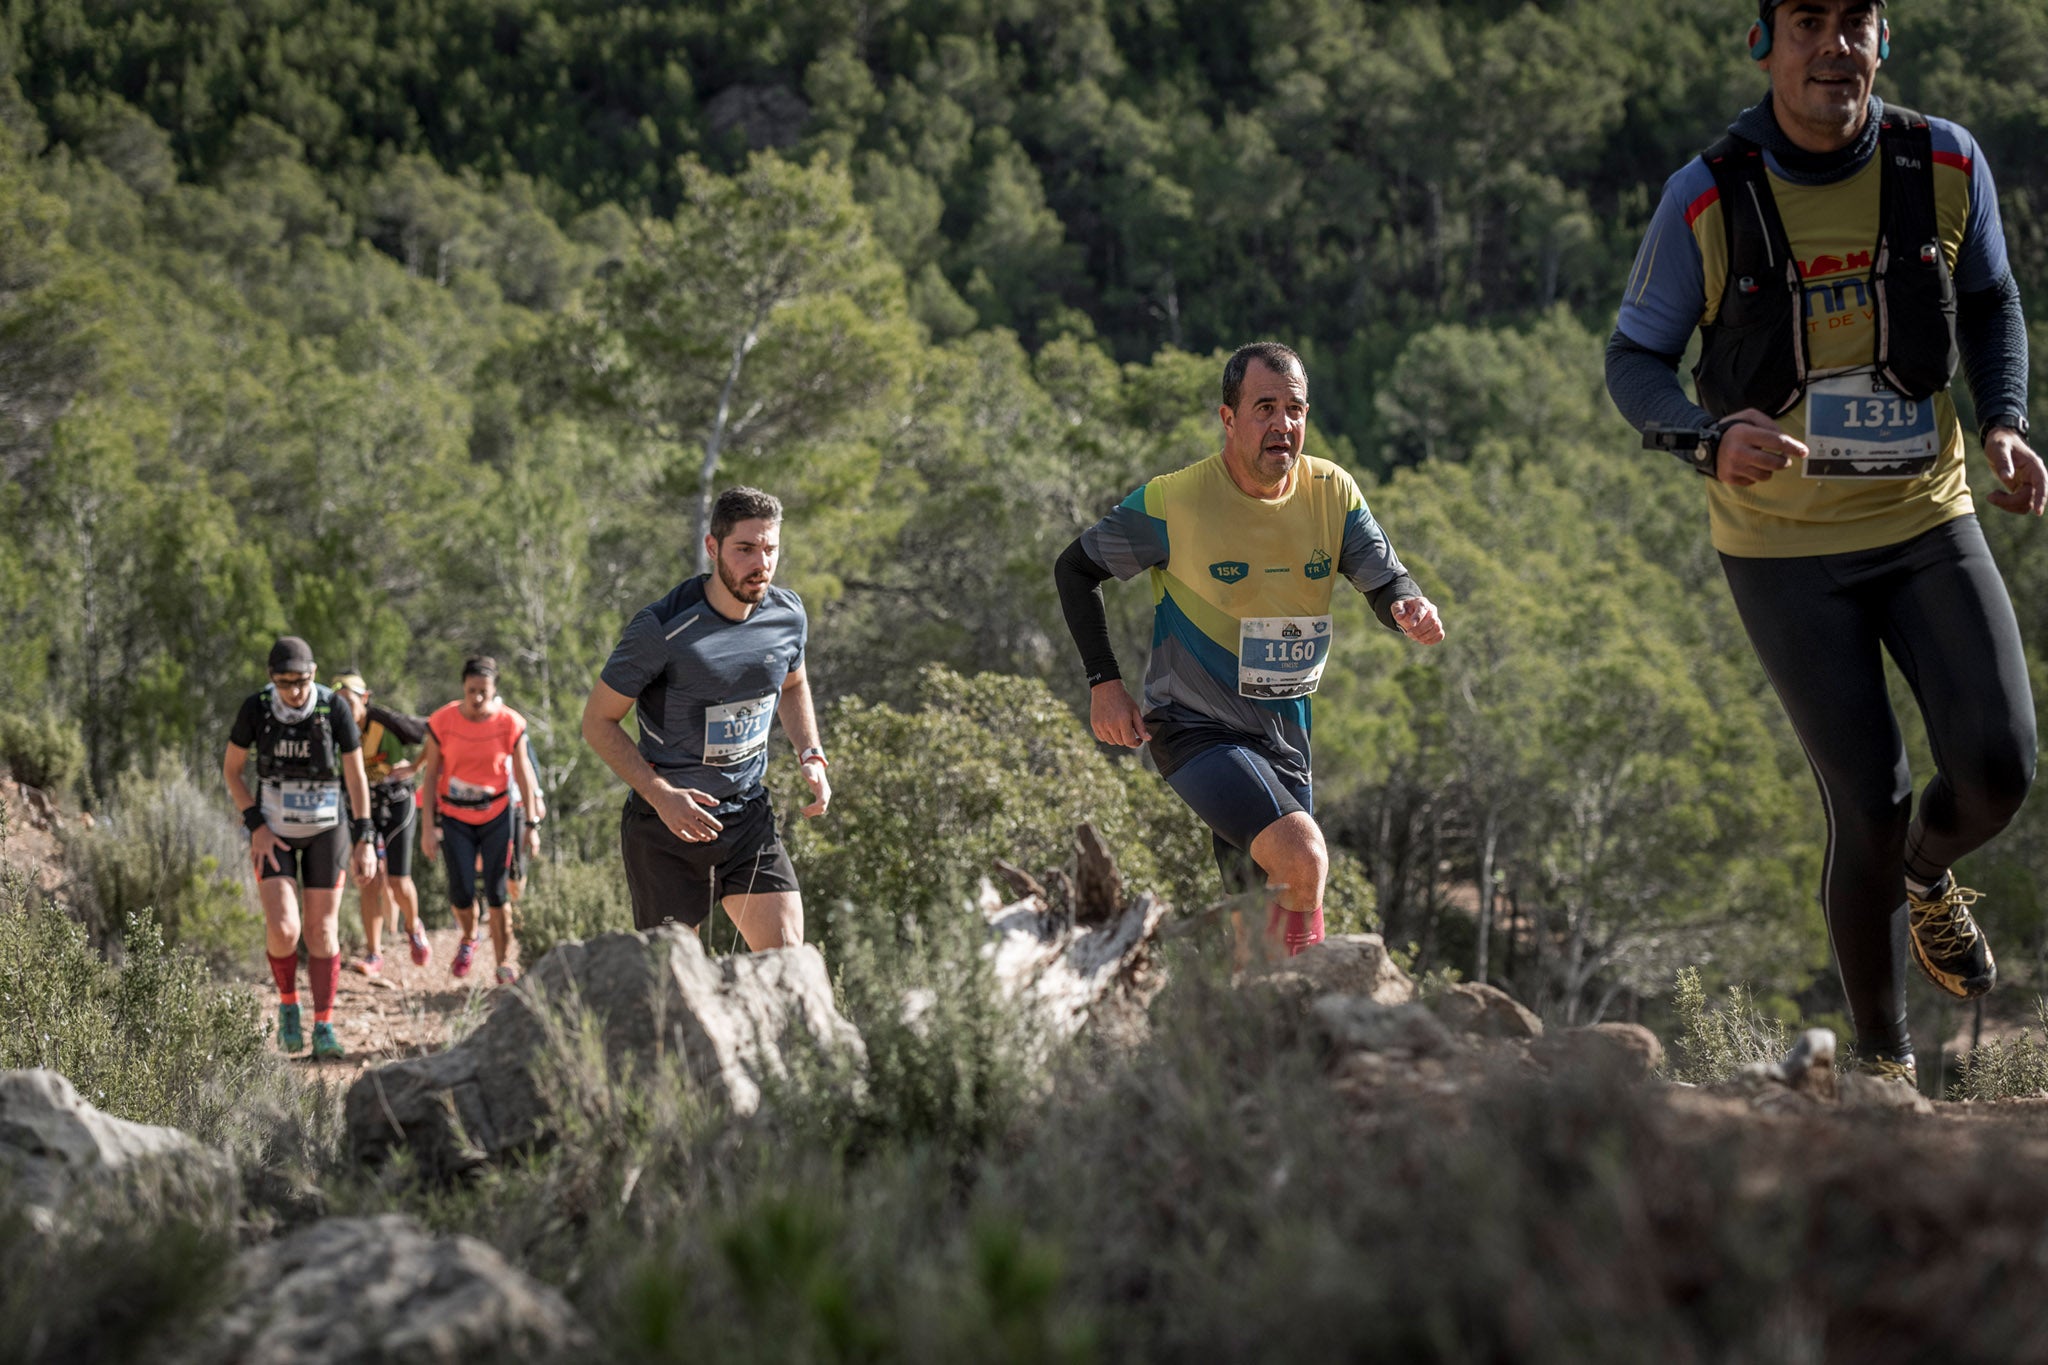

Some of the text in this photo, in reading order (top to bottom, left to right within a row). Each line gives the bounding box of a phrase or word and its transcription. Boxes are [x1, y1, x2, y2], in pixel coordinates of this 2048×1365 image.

[1828, 313, 1855, 329] DE
[1843, 400, 1918, 428] 1319
[1217, 566, 1241, 577] 15K
[1265, 641, 1315, 661] 1160
[724, 717, 761, 738] 1071
